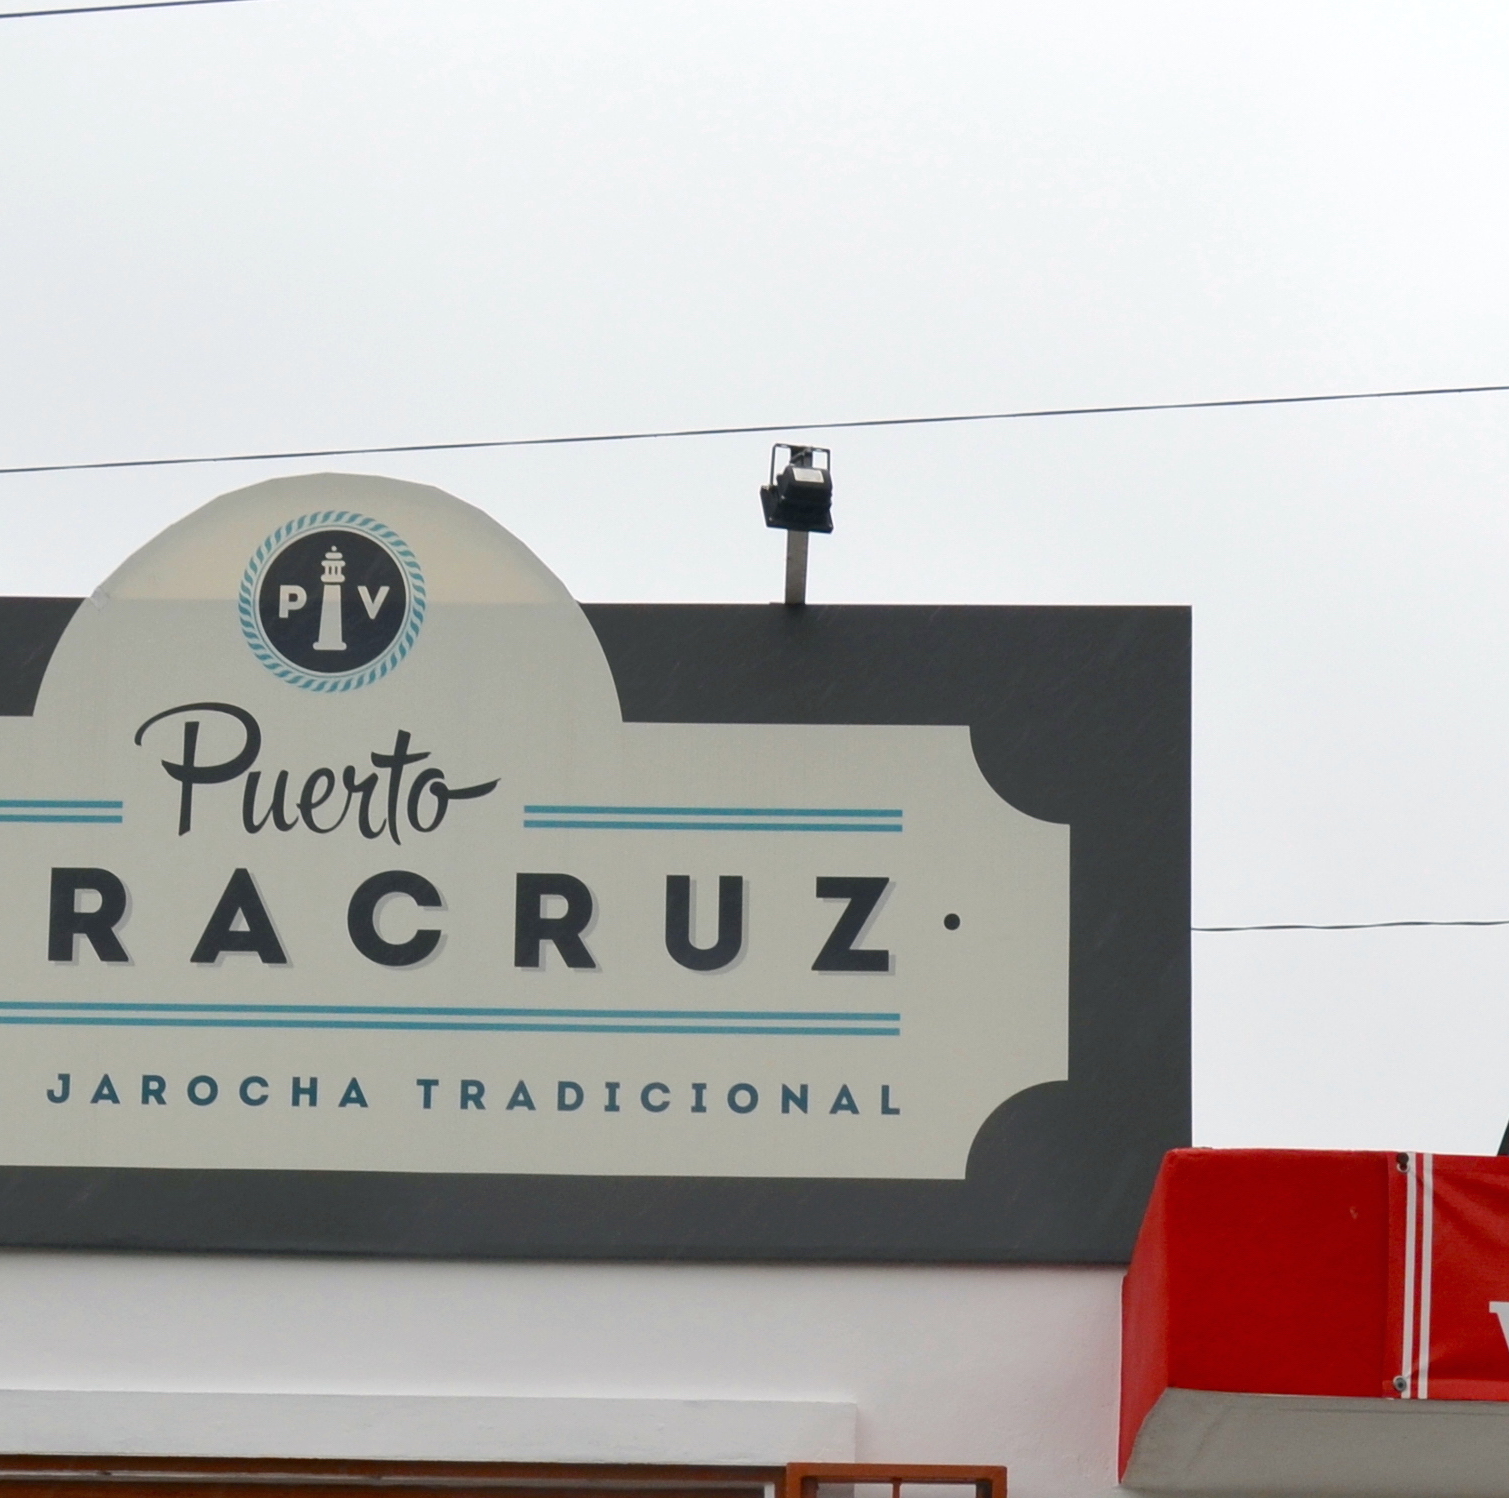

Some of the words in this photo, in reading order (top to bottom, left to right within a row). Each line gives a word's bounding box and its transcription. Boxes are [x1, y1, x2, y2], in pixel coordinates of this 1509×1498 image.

[278, 584, 308, 619] P
[357, 585, 390, 620] V
[134, 702, 501, 846] Puerto
[46, 1073, 369, 1108] JAROCHA
[416, 1078, 901, 1116] TRADICIONAL
